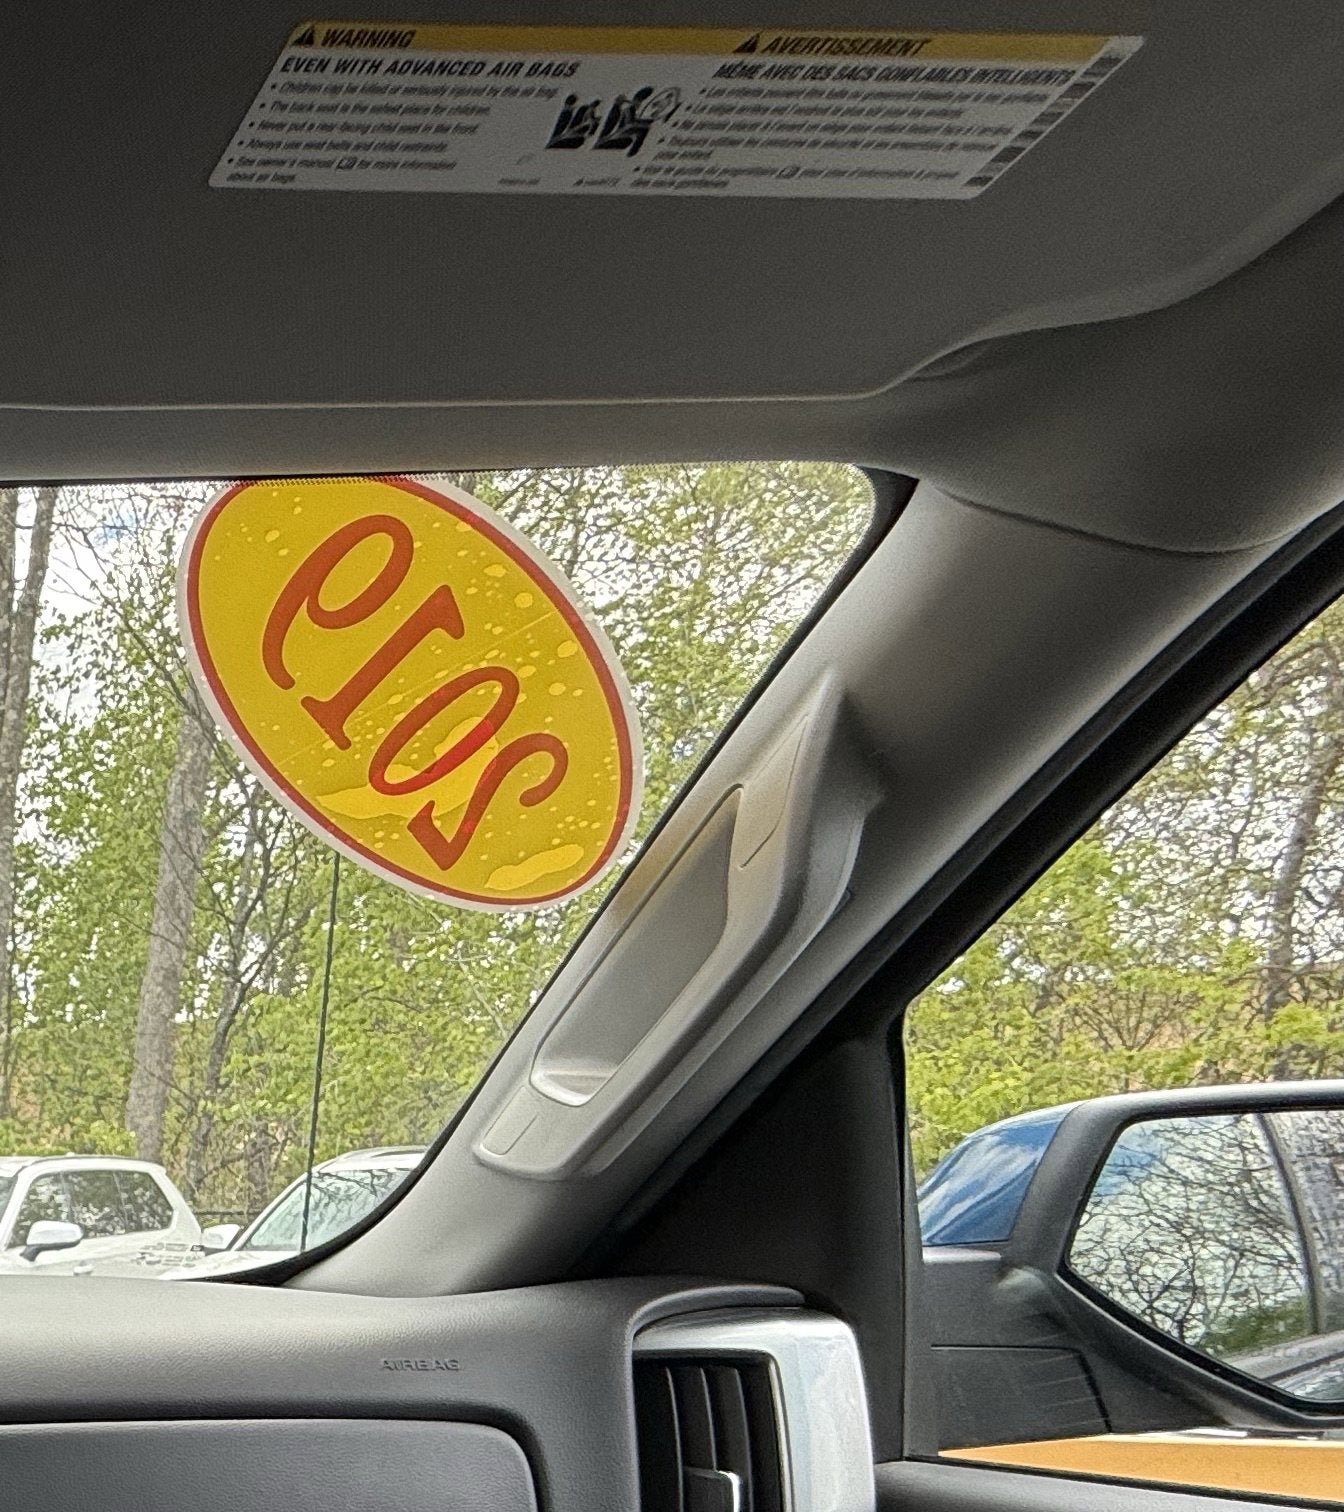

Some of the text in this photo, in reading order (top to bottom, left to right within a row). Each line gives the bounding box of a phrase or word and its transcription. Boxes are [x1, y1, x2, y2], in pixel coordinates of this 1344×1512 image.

[319, 28, 417, 49] WARNING
[760, 36, 932, 56] AVERTISSEMENT
[280, 56, 581, 78] EVEN WITH ADVANCED AIR BAGS
[381, 1358, 460, 1371] AIRBAG
